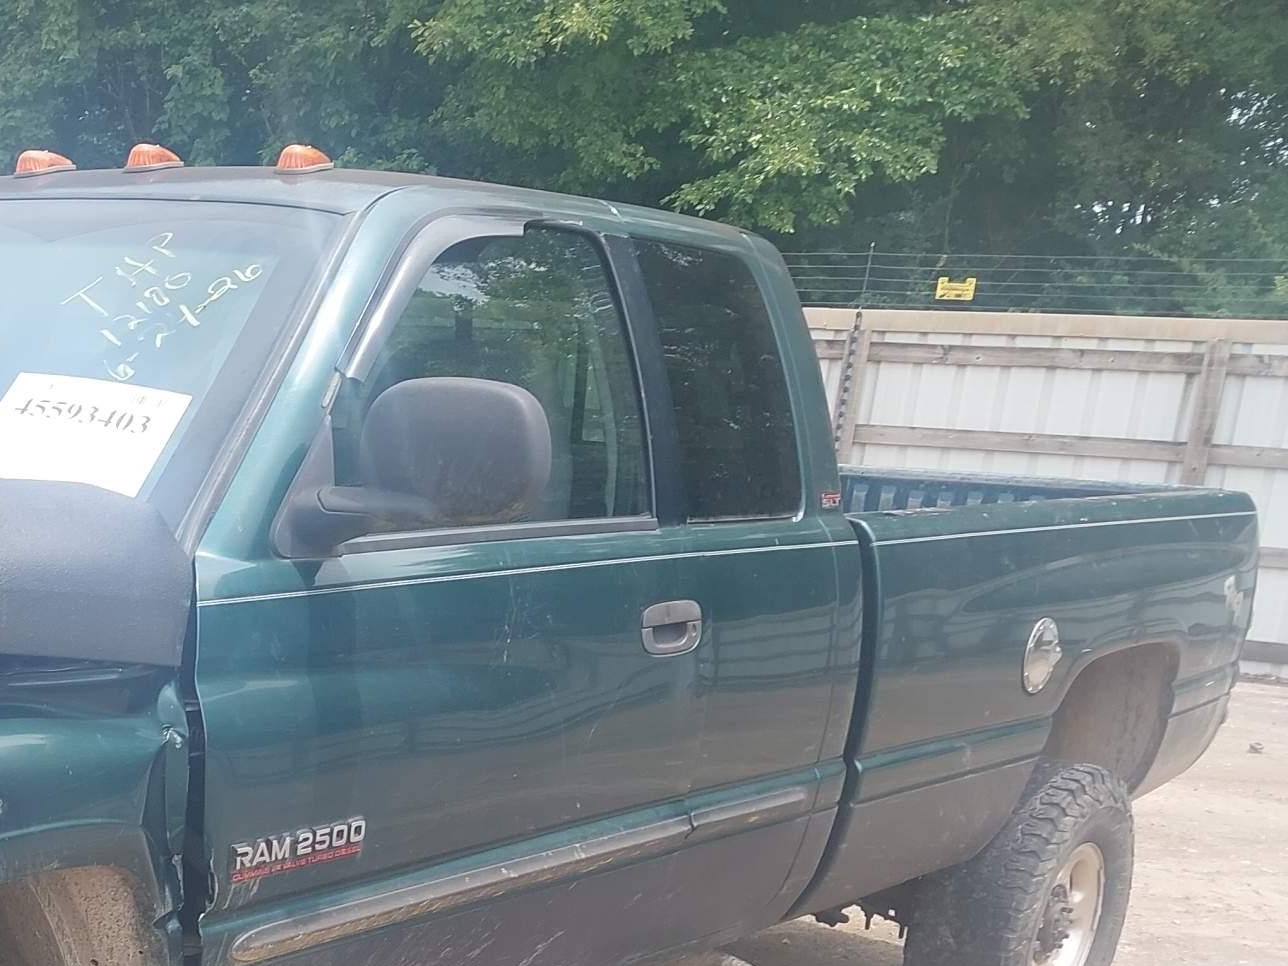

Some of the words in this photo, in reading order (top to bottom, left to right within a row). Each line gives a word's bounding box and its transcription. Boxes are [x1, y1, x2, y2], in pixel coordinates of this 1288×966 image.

[14, 398, 151, 434] 45593403
[235, 836, 291, 870] RAM
[296, 819, 366, 856] 2500
